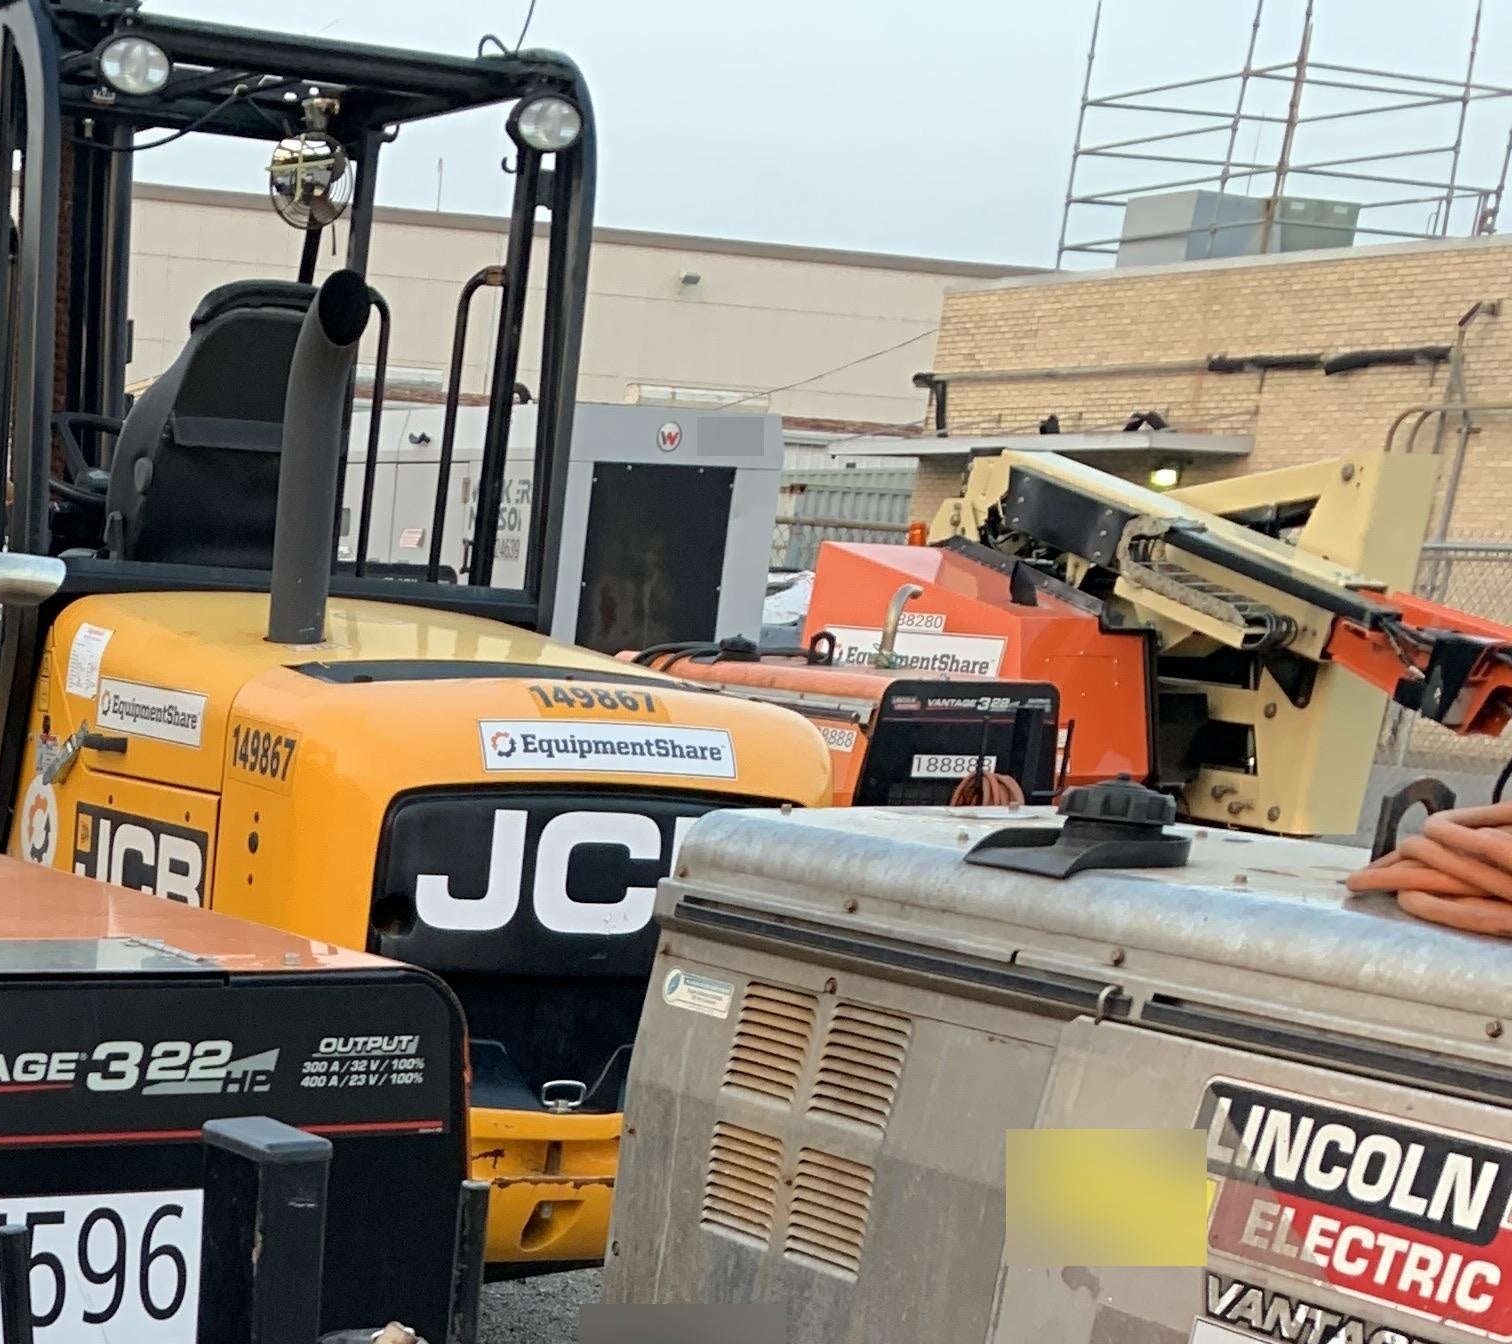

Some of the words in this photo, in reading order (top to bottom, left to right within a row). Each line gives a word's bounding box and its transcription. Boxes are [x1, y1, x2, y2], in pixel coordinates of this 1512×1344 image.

[111, 693, 198, 730] EquipmentShare
[529, 685, 656, 713] 149867
[231, 723, 297, 782] 149867
[520, 733, 723, 761] EquipmentShare
[416, 809, 701, 935] JC
[318, 1035, 414, 1053] OUTPUT
[86, 1039, 234, 1092] 322
[300, 1075, 328, 1088] 400
[389, 1072, 424, 1085] 100%
[302, 1060, 328, 1074] 300
[391, 1057, 426, 1071] 100%
[1207, 1096, 1500, 1231] LINCOLN
[1240, 1197, 1502, 1314] ELECTRIC
